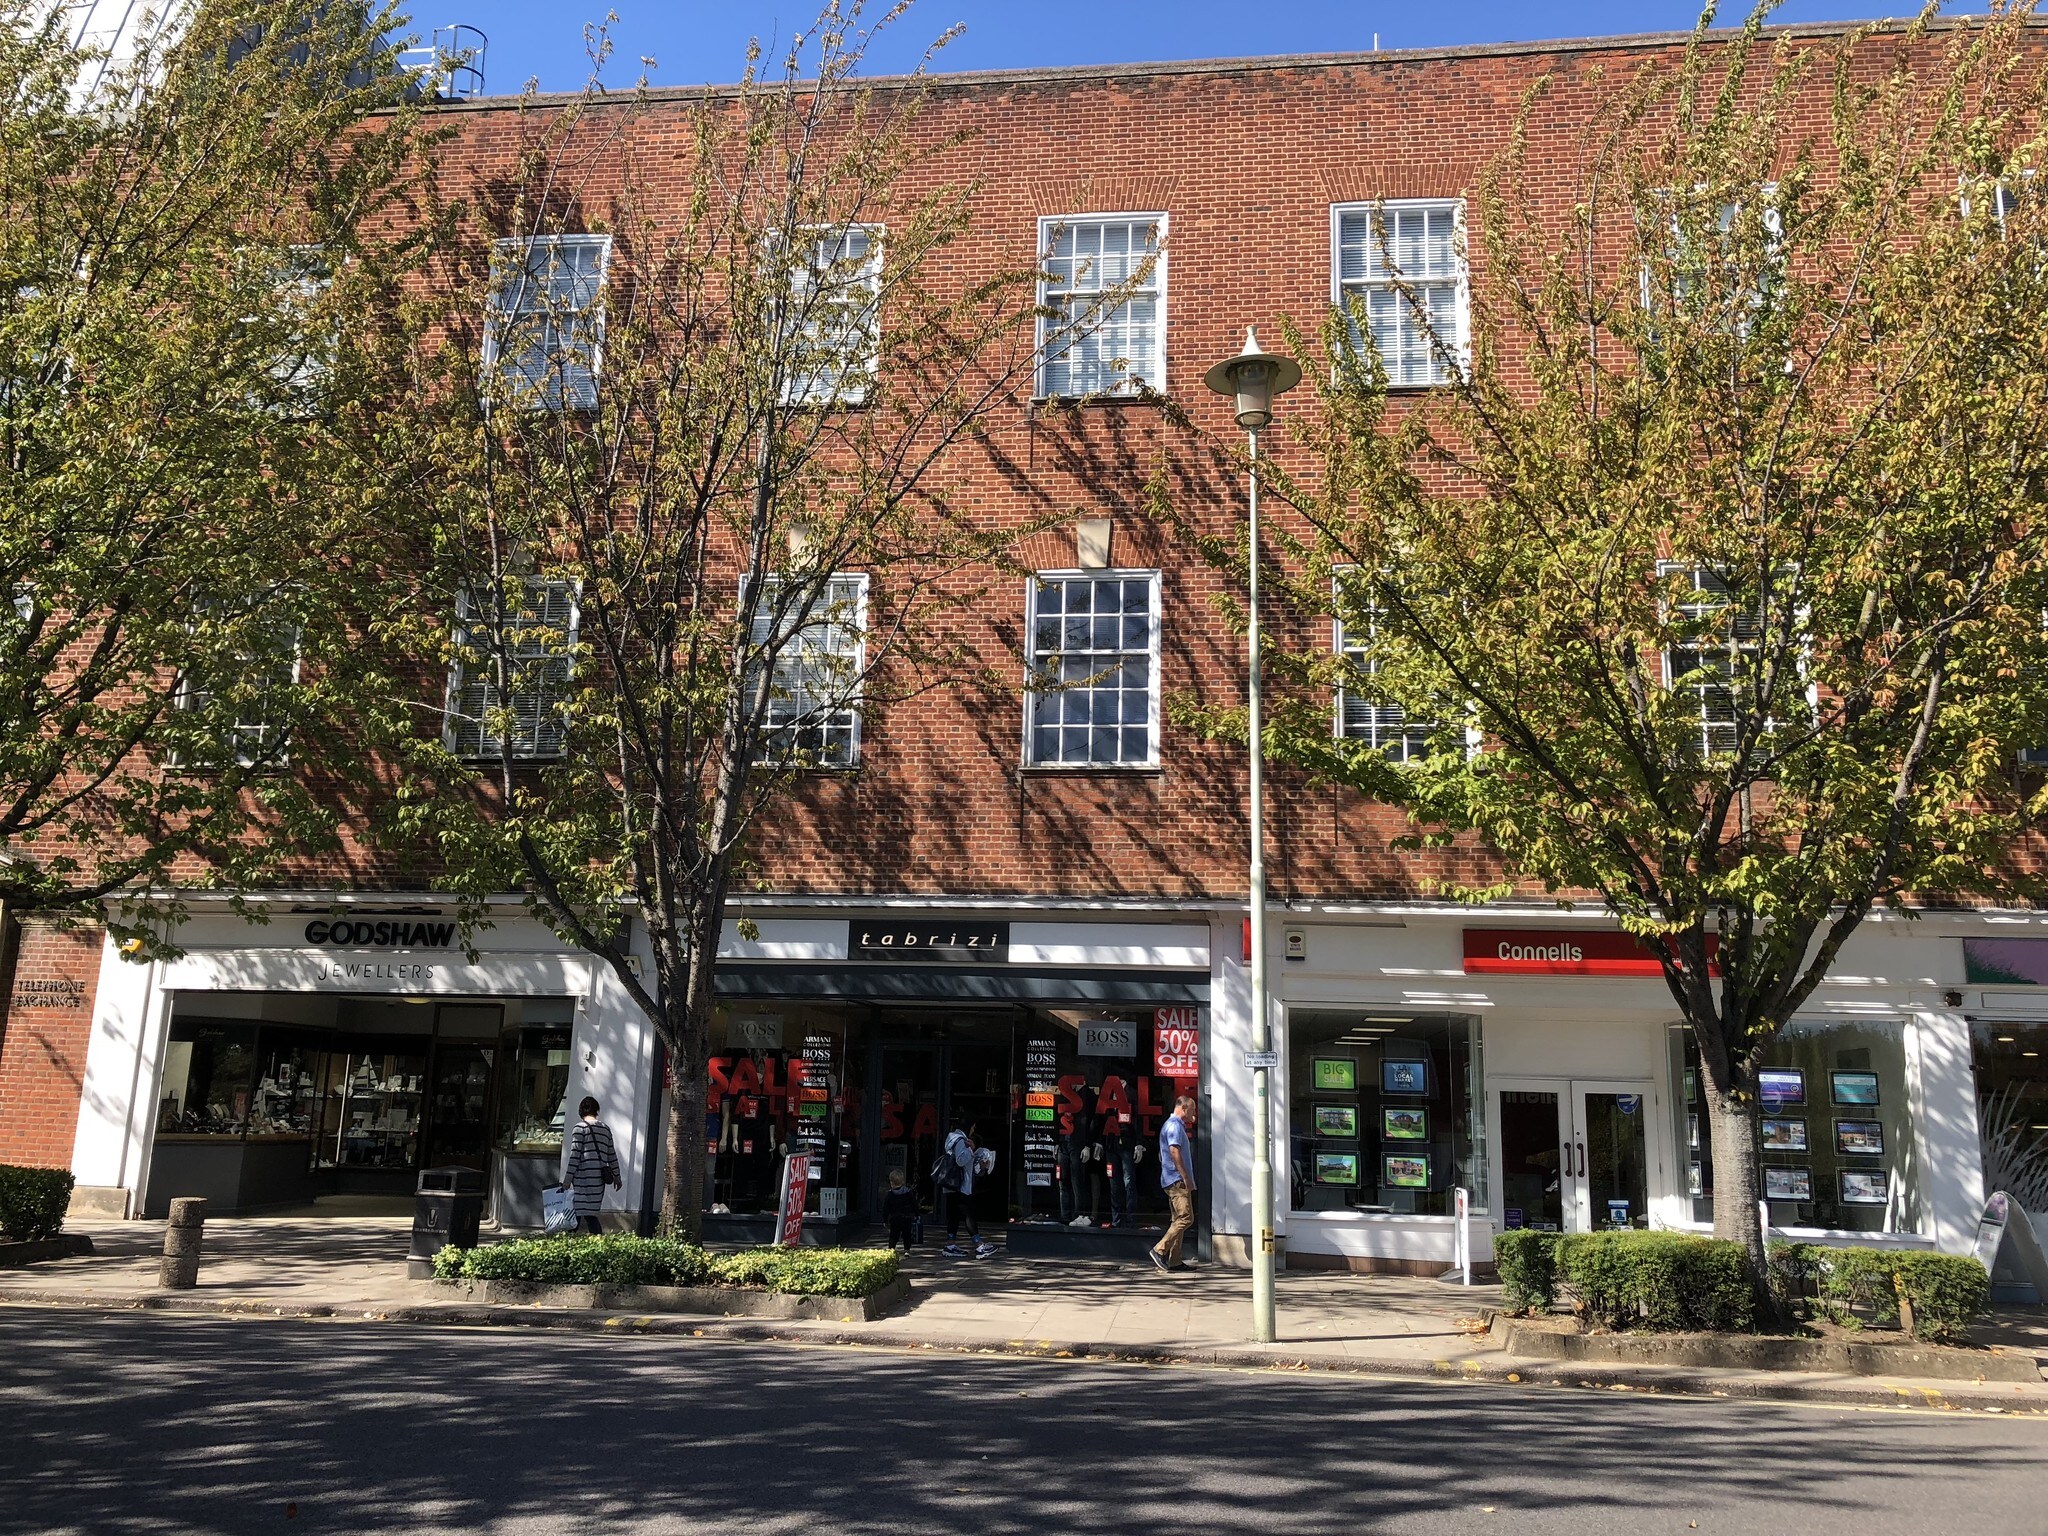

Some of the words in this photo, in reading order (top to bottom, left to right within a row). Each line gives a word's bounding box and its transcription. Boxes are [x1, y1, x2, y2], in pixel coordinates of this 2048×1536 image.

[305, 920, 455, 946] GODSHAW
[861, 932, 997, 947] tabrizi
[1498, 941, 1583, 962] Connells
[318, 963, 434, 980] JEWELLERS
[18, 980, 86, 993] TELEPHONE
[15, 994, 81, 1008] EXCHANGE
[1157, 1008, 1198, 1030] SALE
[736, 1023, 776, 1036] BOSS
[1086, 1029, 1129, 1044] BOSS
[1158, 1030, 1198, 1054] 50%
[803, 1049, 831, 1058] BOSS
[1027, 1053, 1056, 1062] BOSS
[1157, 1055, 1198, 1068] OFF
[1323, 1063, 1345, 1075] BIG
[1324, 1074, 1345, 1084] SALE
[803, 1091, 826, 1099] BOSS
[1027, 1094, 1052, 1102] BOSS
[802, 1104, 826, 1112] BOSS
[1027, 1109, 1053, 1117] BOSS
[789, 1156, 808, 1185] SALE
[786, 1186, 803, 1217] 50%
[784, 1218, 801, 1236] OFF
